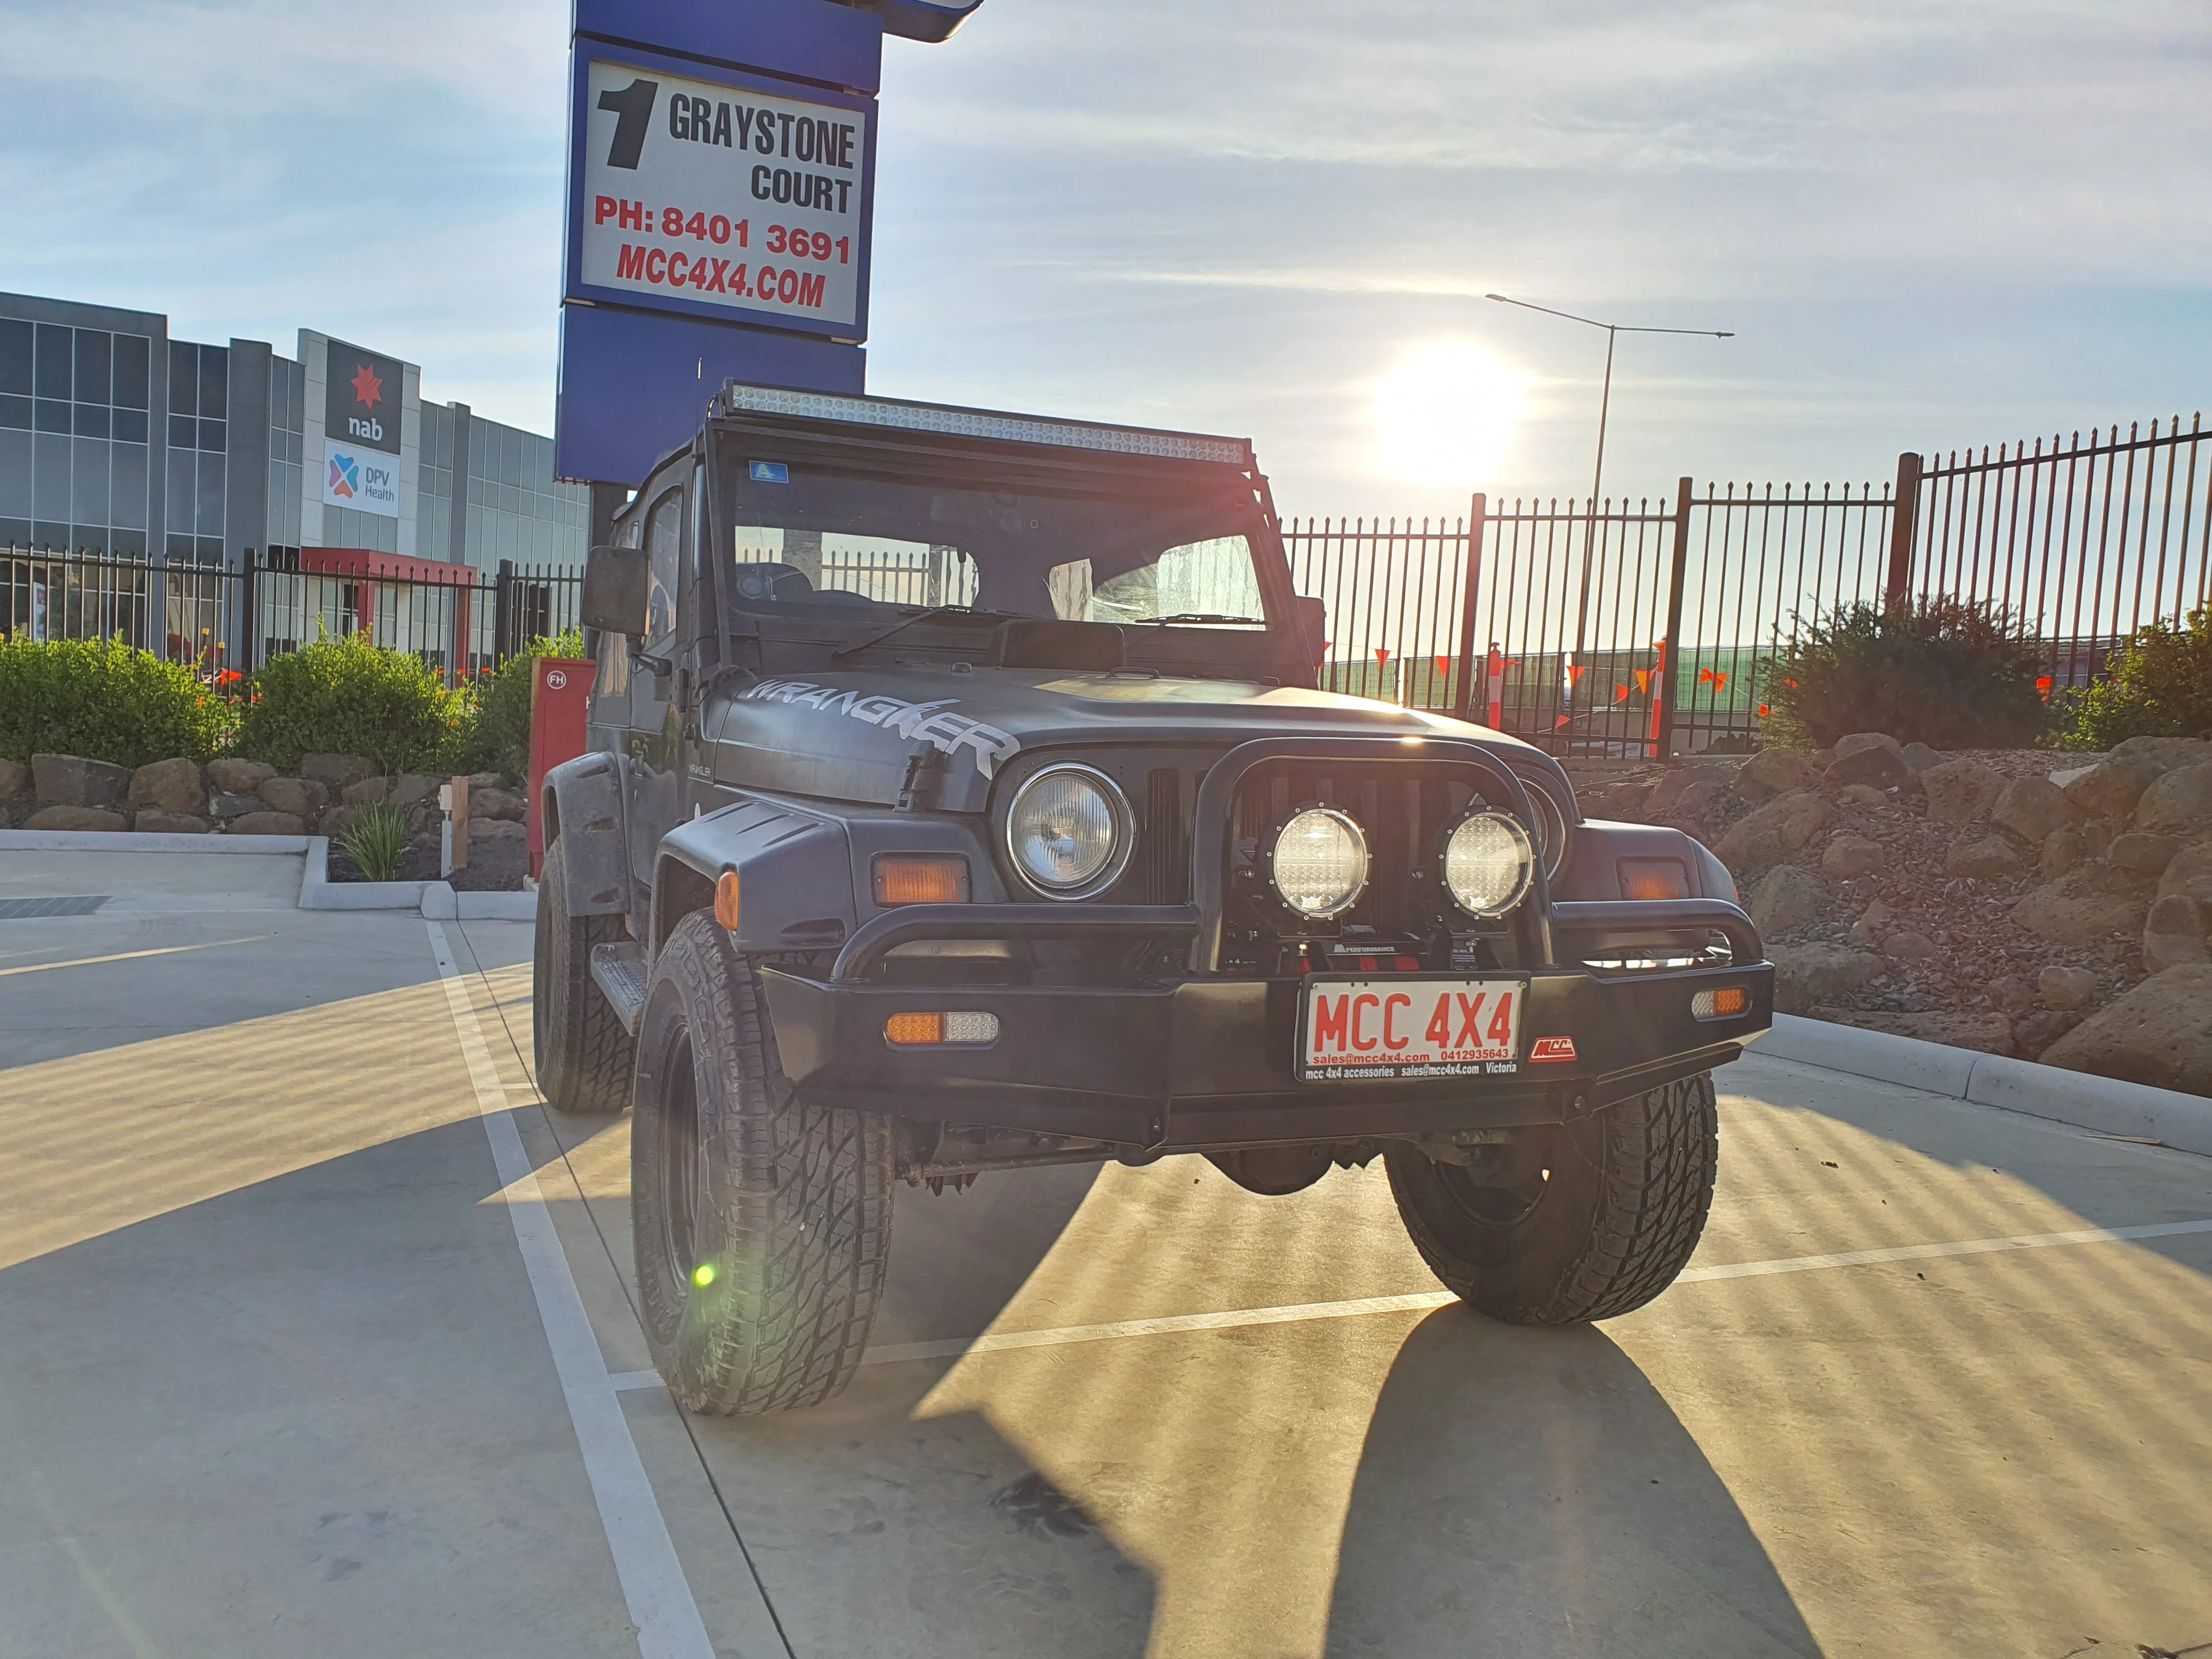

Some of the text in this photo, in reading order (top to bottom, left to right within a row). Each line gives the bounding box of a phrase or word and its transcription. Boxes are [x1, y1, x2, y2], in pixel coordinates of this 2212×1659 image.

[597, 78, 855, 170] 1 GRAYSTONE
[751, 165, 853, 214] COURT
[595, 195, 849, 264] PH: 8401 3691
[616, 244, 826, 308] MCC4X4.COM
[349, 417, 383, 441] nab
[366, 466, 390, 487] DPV
[365, 485, 394, 503] Health
[550, 675, 563, 684] FH
[1314, 992, 1513, 1052] MCC 4X4
[1313, 1048, 1509, 1064] sales@mcc4x4.com 0412935643
[1306, 1061, 1517, 1079] mcc 4x4 accessories sales@mcc4x4.com Victoria
